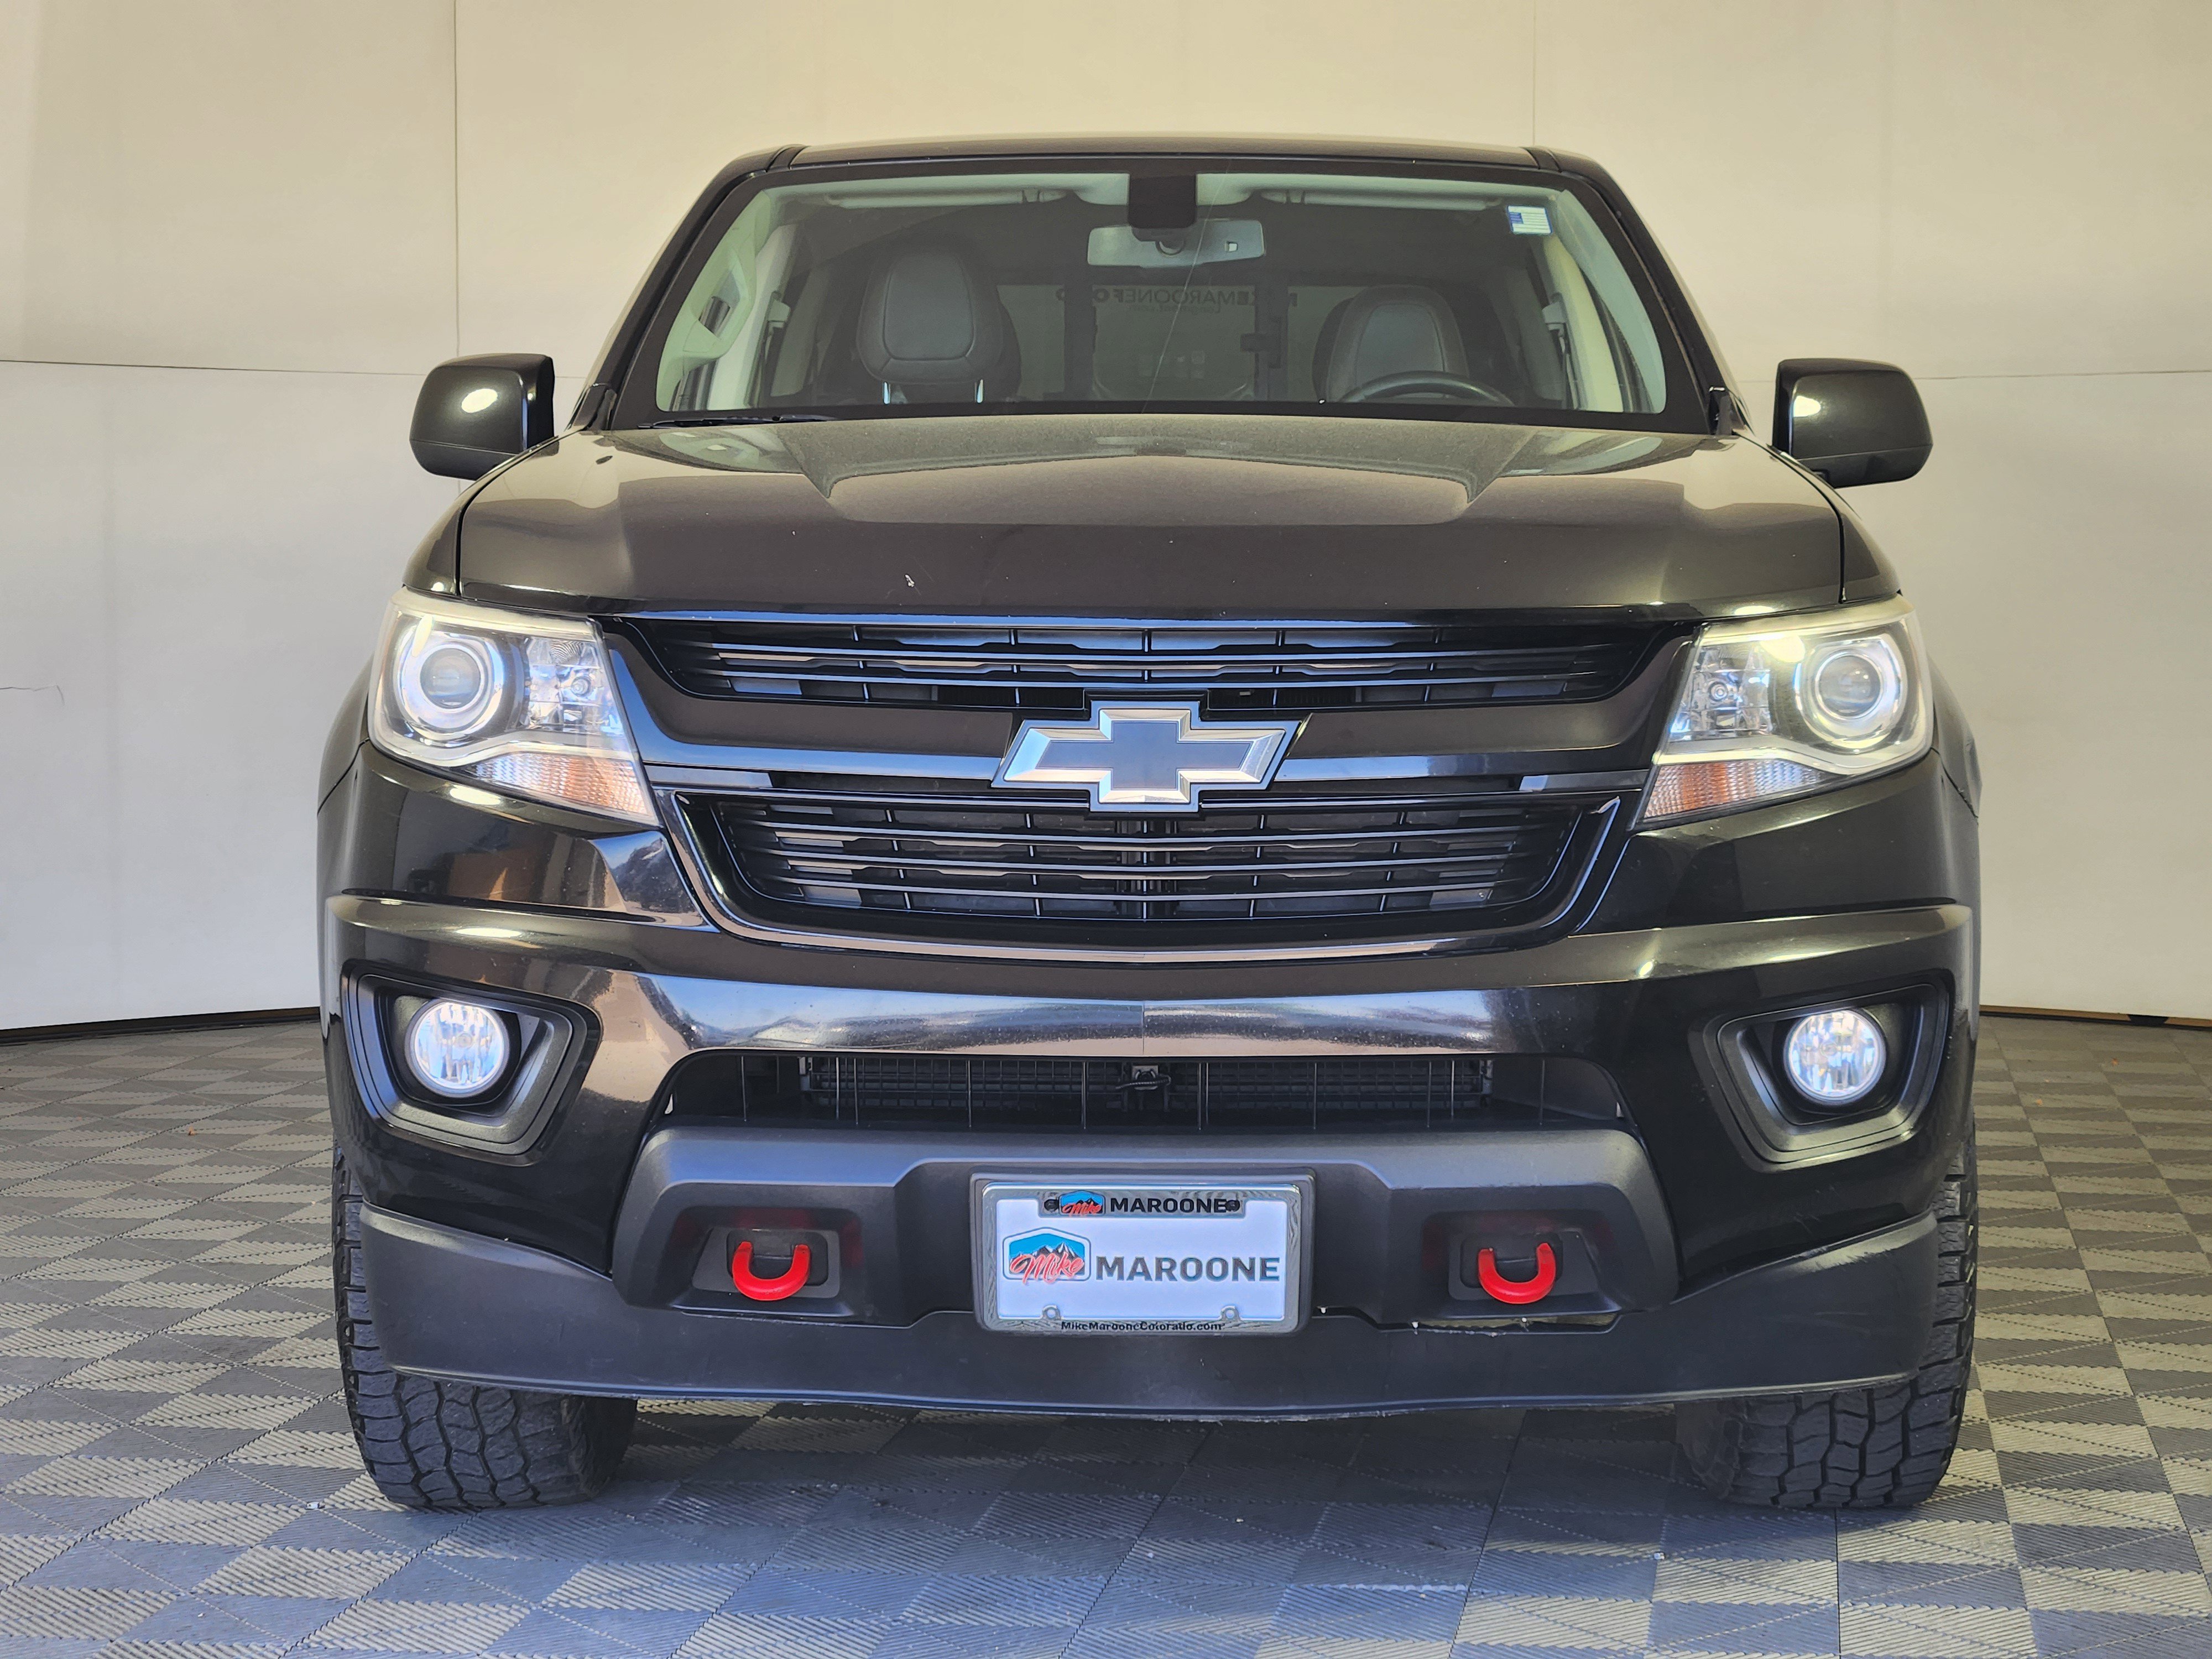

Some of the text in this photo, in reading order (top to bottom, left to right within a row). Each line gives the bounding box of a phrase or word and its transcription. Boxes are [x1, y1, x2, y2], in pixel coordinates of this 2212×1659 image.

[1062, 1197, 1227, 1216] Mike MAROONE
[1010, 1252, 1280, 1286] Mike MAROONE
[1061, 1321, 1222, 1331] MikeMarooneColorado.com
